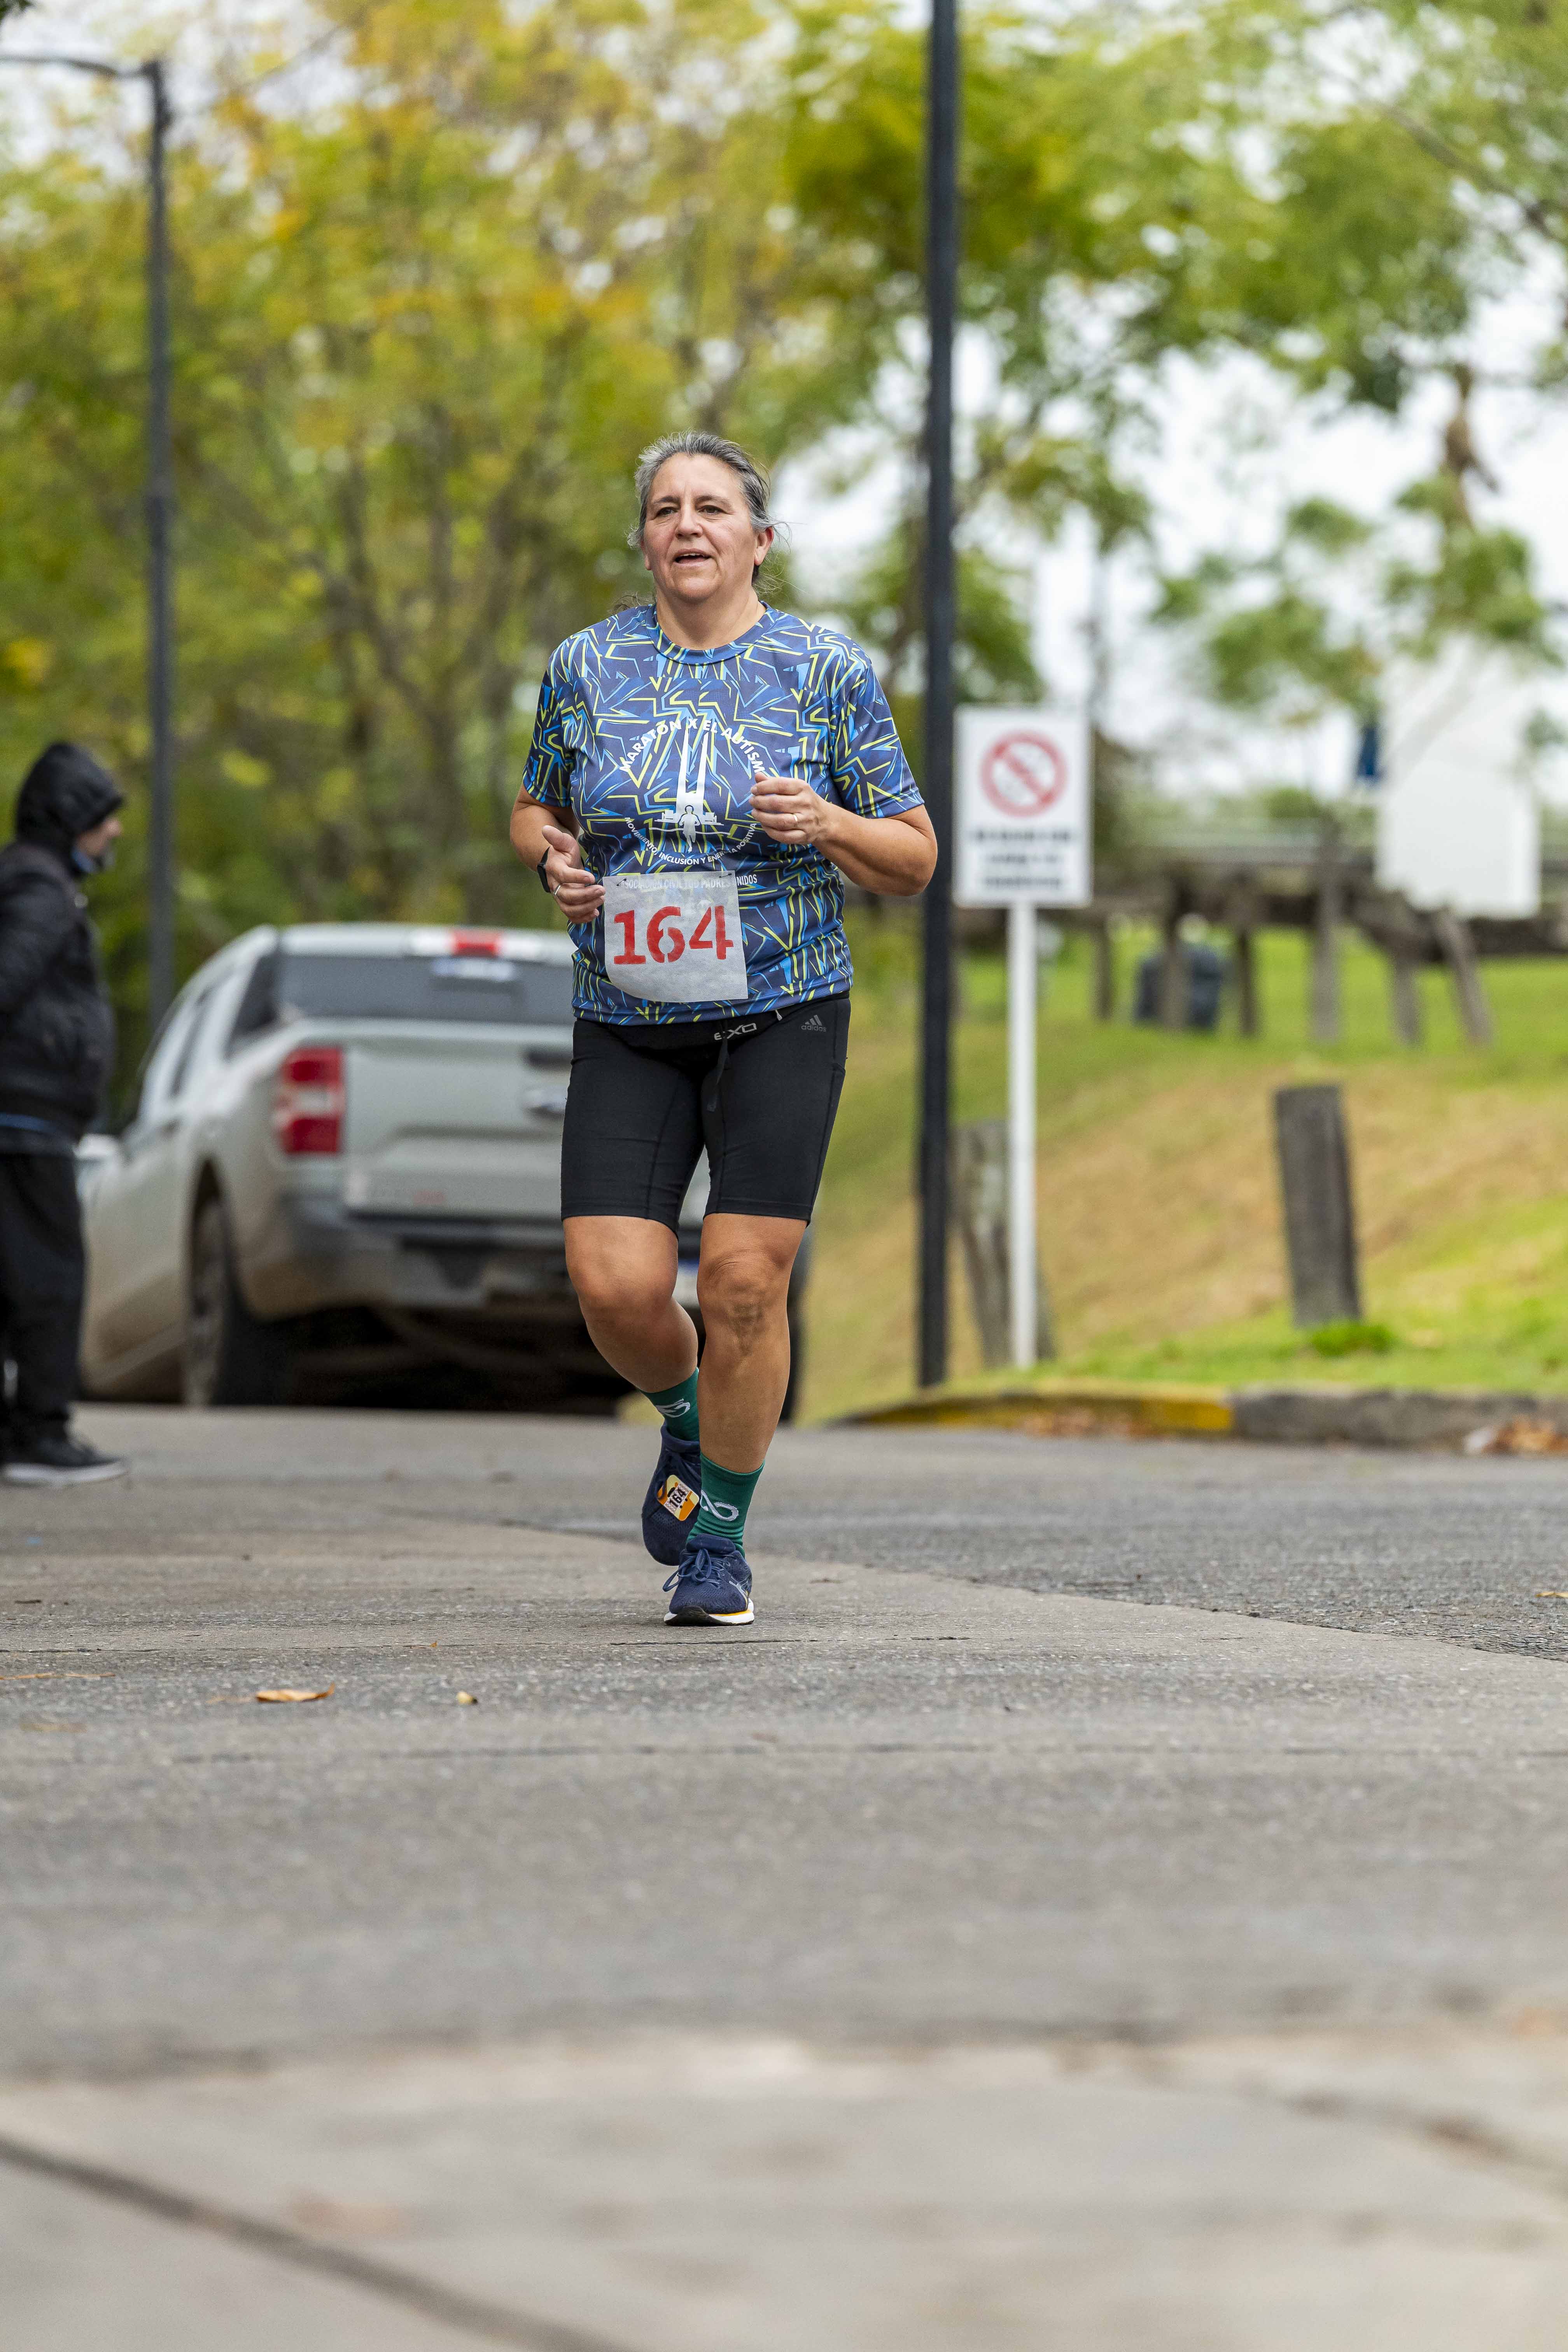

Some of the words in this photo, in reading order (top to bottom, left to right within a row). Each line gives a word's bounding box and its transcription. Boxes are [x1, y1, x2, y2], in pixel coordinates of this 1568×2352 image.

[688, 718, 698, 729] X
[703, 719, 718, 733] EL
[721, 727, 766, 773] AUTISM
[624, 817, 658, 856] MOVIMIENTO,
[658, 852, 700, 865] INCLUSIÓN
[736, 823, 757, 850] POSITIVA
[735, 874, 758, 886] NIDOS
[613, 905, 734, 965] 164
[669, 1488, 686, 1507] 164
